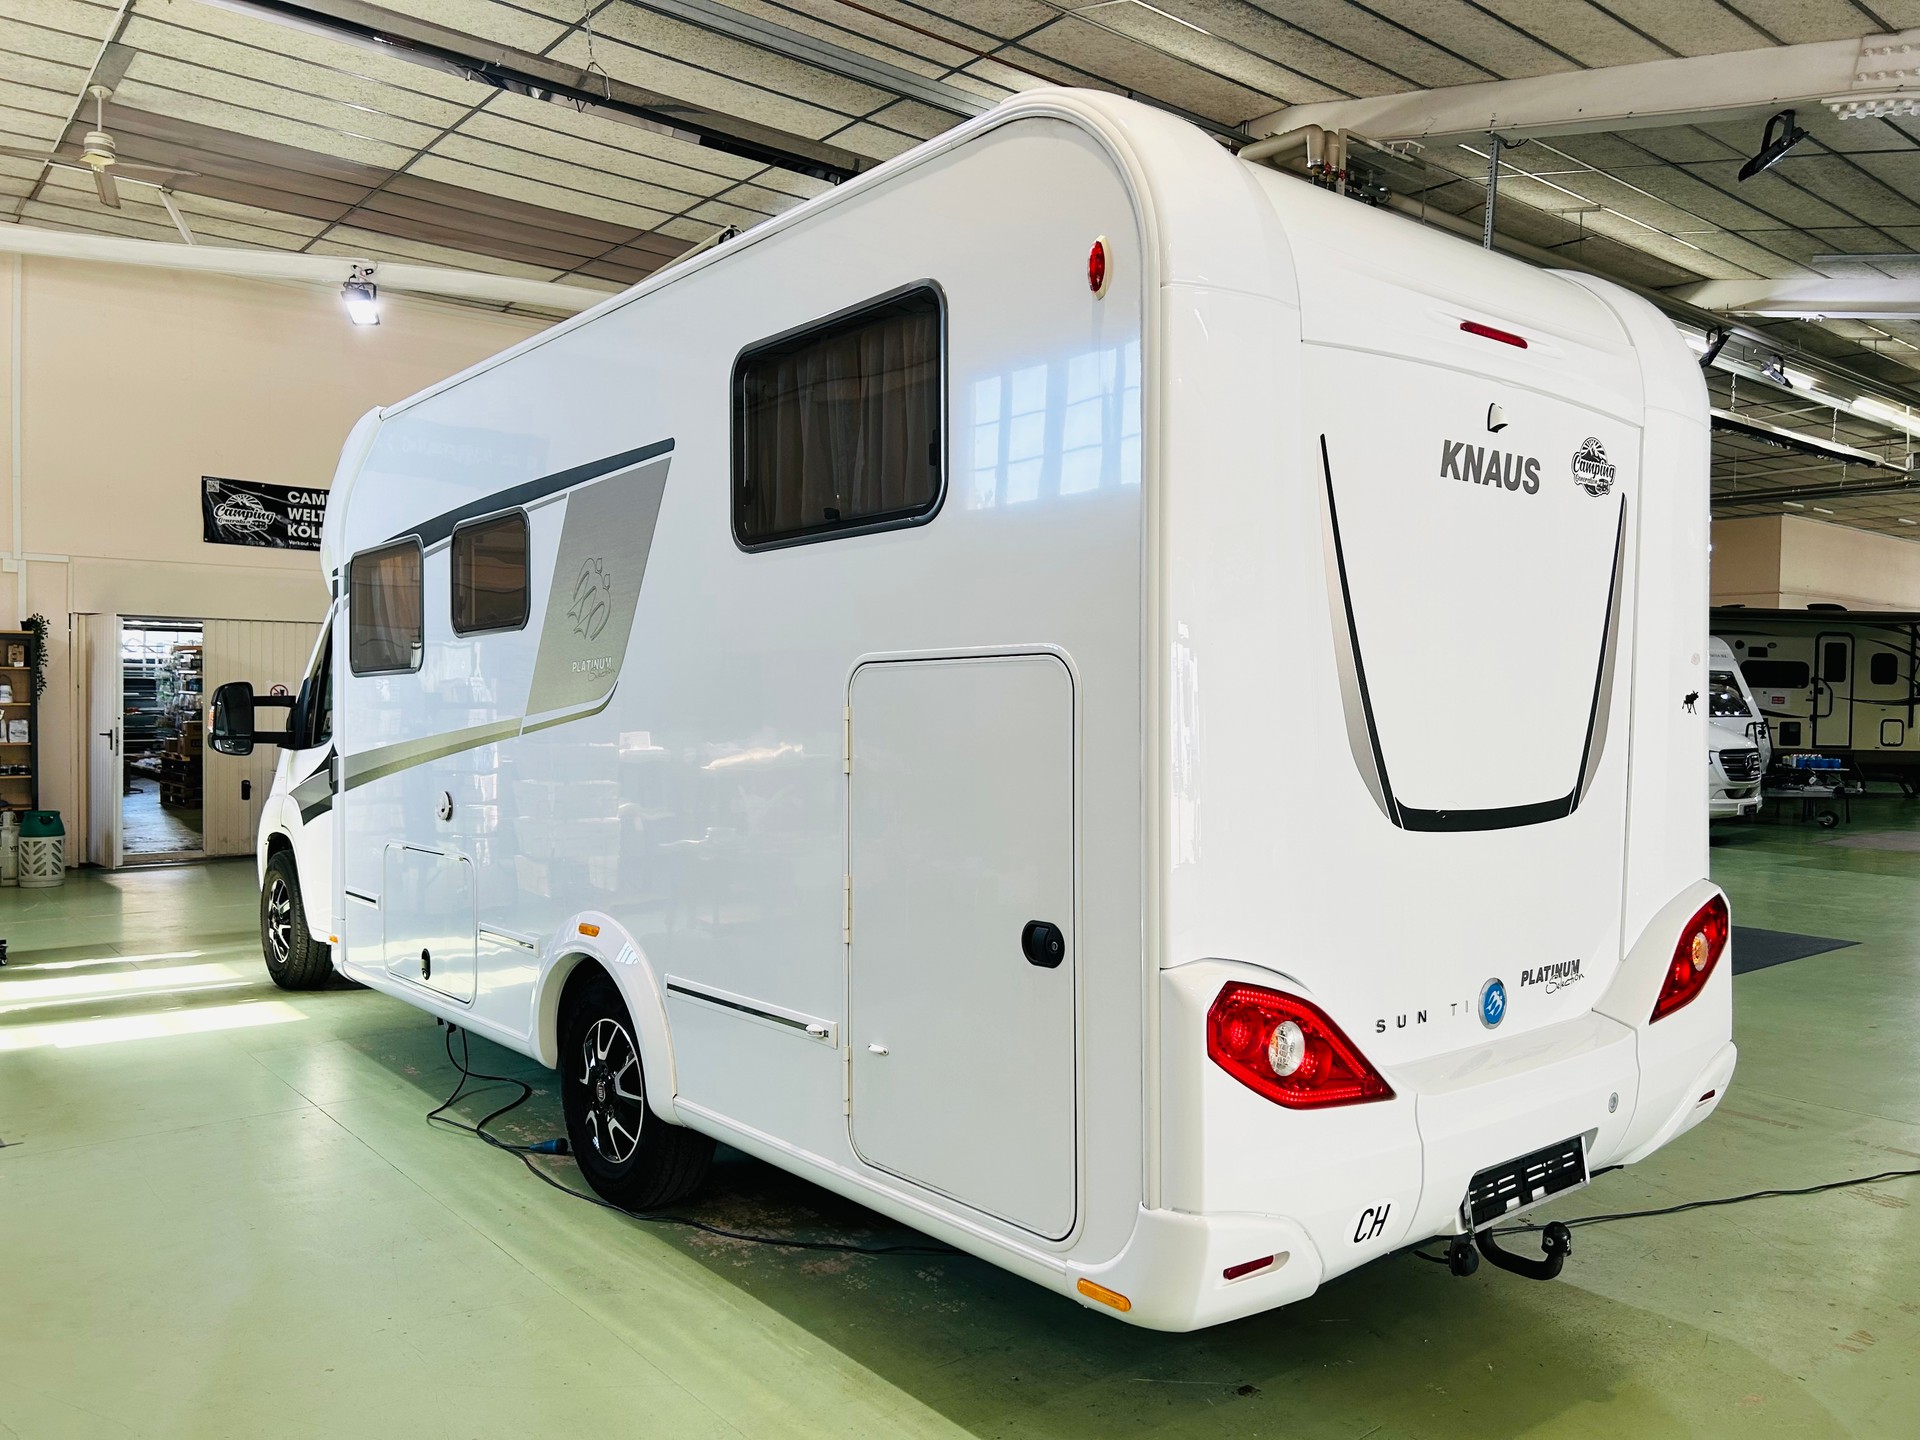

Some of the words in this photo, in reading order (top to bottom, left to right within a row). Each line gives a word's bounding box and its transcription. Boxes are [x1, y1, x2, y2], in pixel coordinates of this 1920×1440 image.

[1440, 439, 1541, 495] KNAUS
[1573, 454, 1615, 483] Camping
[214, 504, 275, 525] Camping
[287, 507, 325, 523] WELT
[571, 656, 613, 673] PLATINUM
[1520, 958, 1581, 988] PLATINUM
[1545, 974, 1585, 995] Selection
[1375, 1009, 1427, 1034] SUN
[1450, 1000, 1469, 1017] TI
[1353, 1203, 1391, 1244] CH
